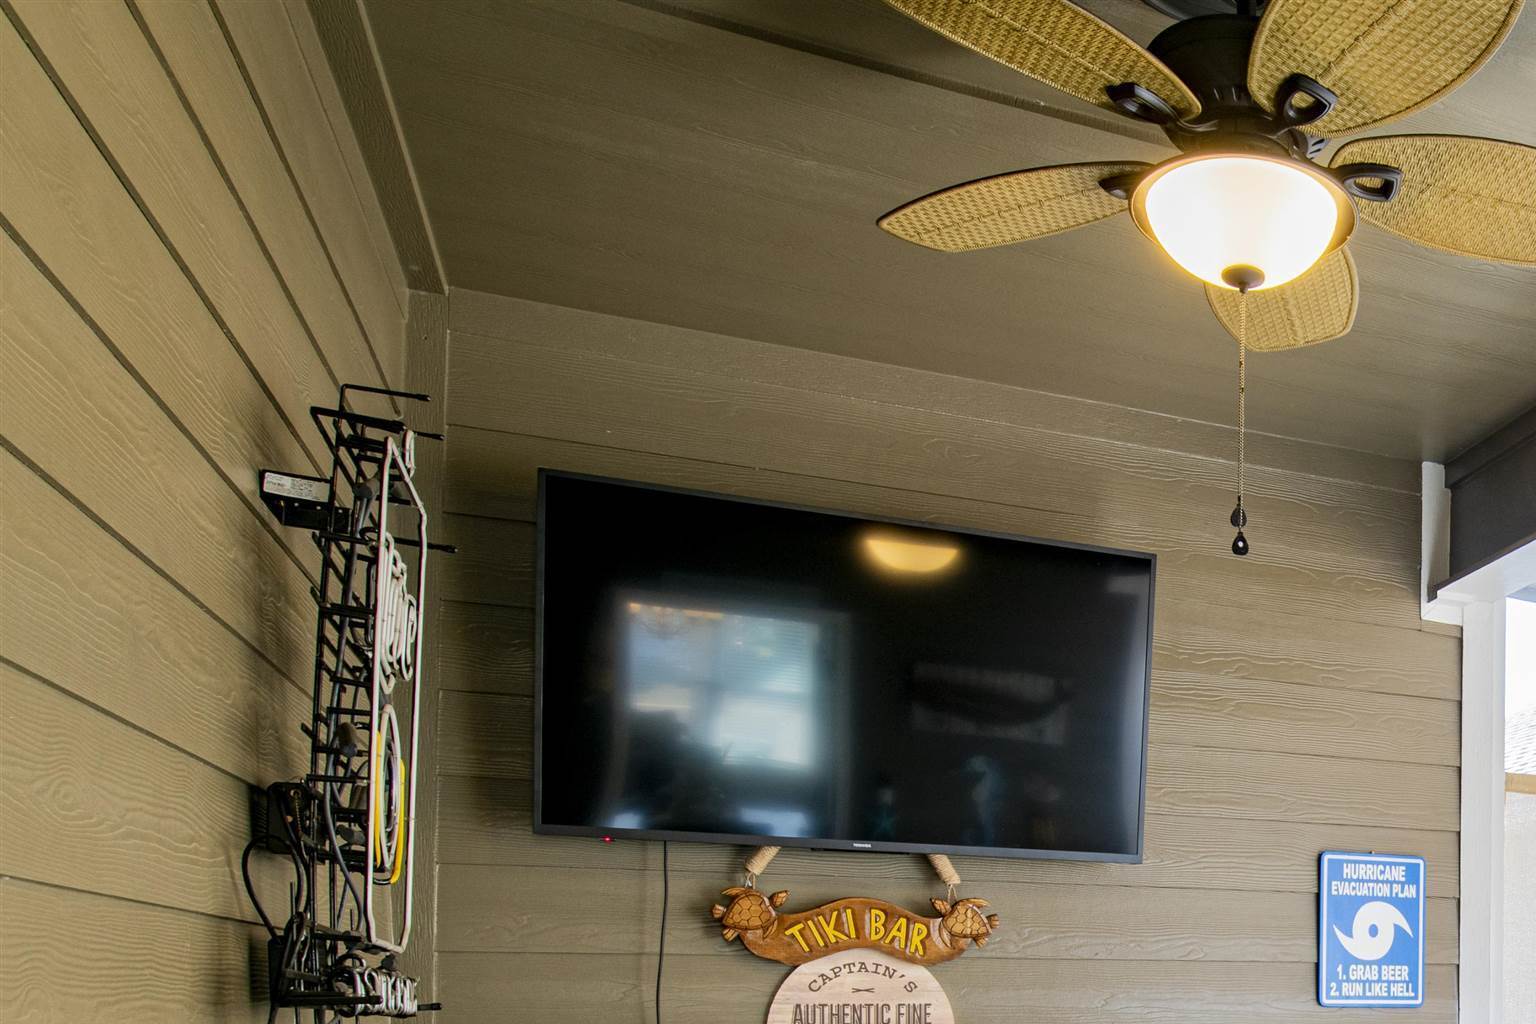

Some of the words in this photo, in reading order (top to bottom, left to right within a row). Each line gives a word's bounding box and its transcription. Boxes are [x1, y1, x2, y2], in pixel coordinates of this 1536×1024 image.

[1343, 863, 1406, 882] HURRICANE
[1331, 881, 1391, 898] EVACUATION
[1392, 884, 1417, 899] PLAN
[785, 908, 857, 953] TIKI
[870, 908, 928, 956] BAR
[808, 961, 918, 993] CAPTAIN'S
[1336, 964, 1346, 980] 1.
[1349, 965, 1379, 981] GRAB
[1381, 965, 1409, 981] BEER
[1330, 983, 1340, 997] 2.
[1342, 983, 1364, 997] RUN
[1365, 983, 1388, 997] LIKE
[1390, 983, 1415, 997] HELL
